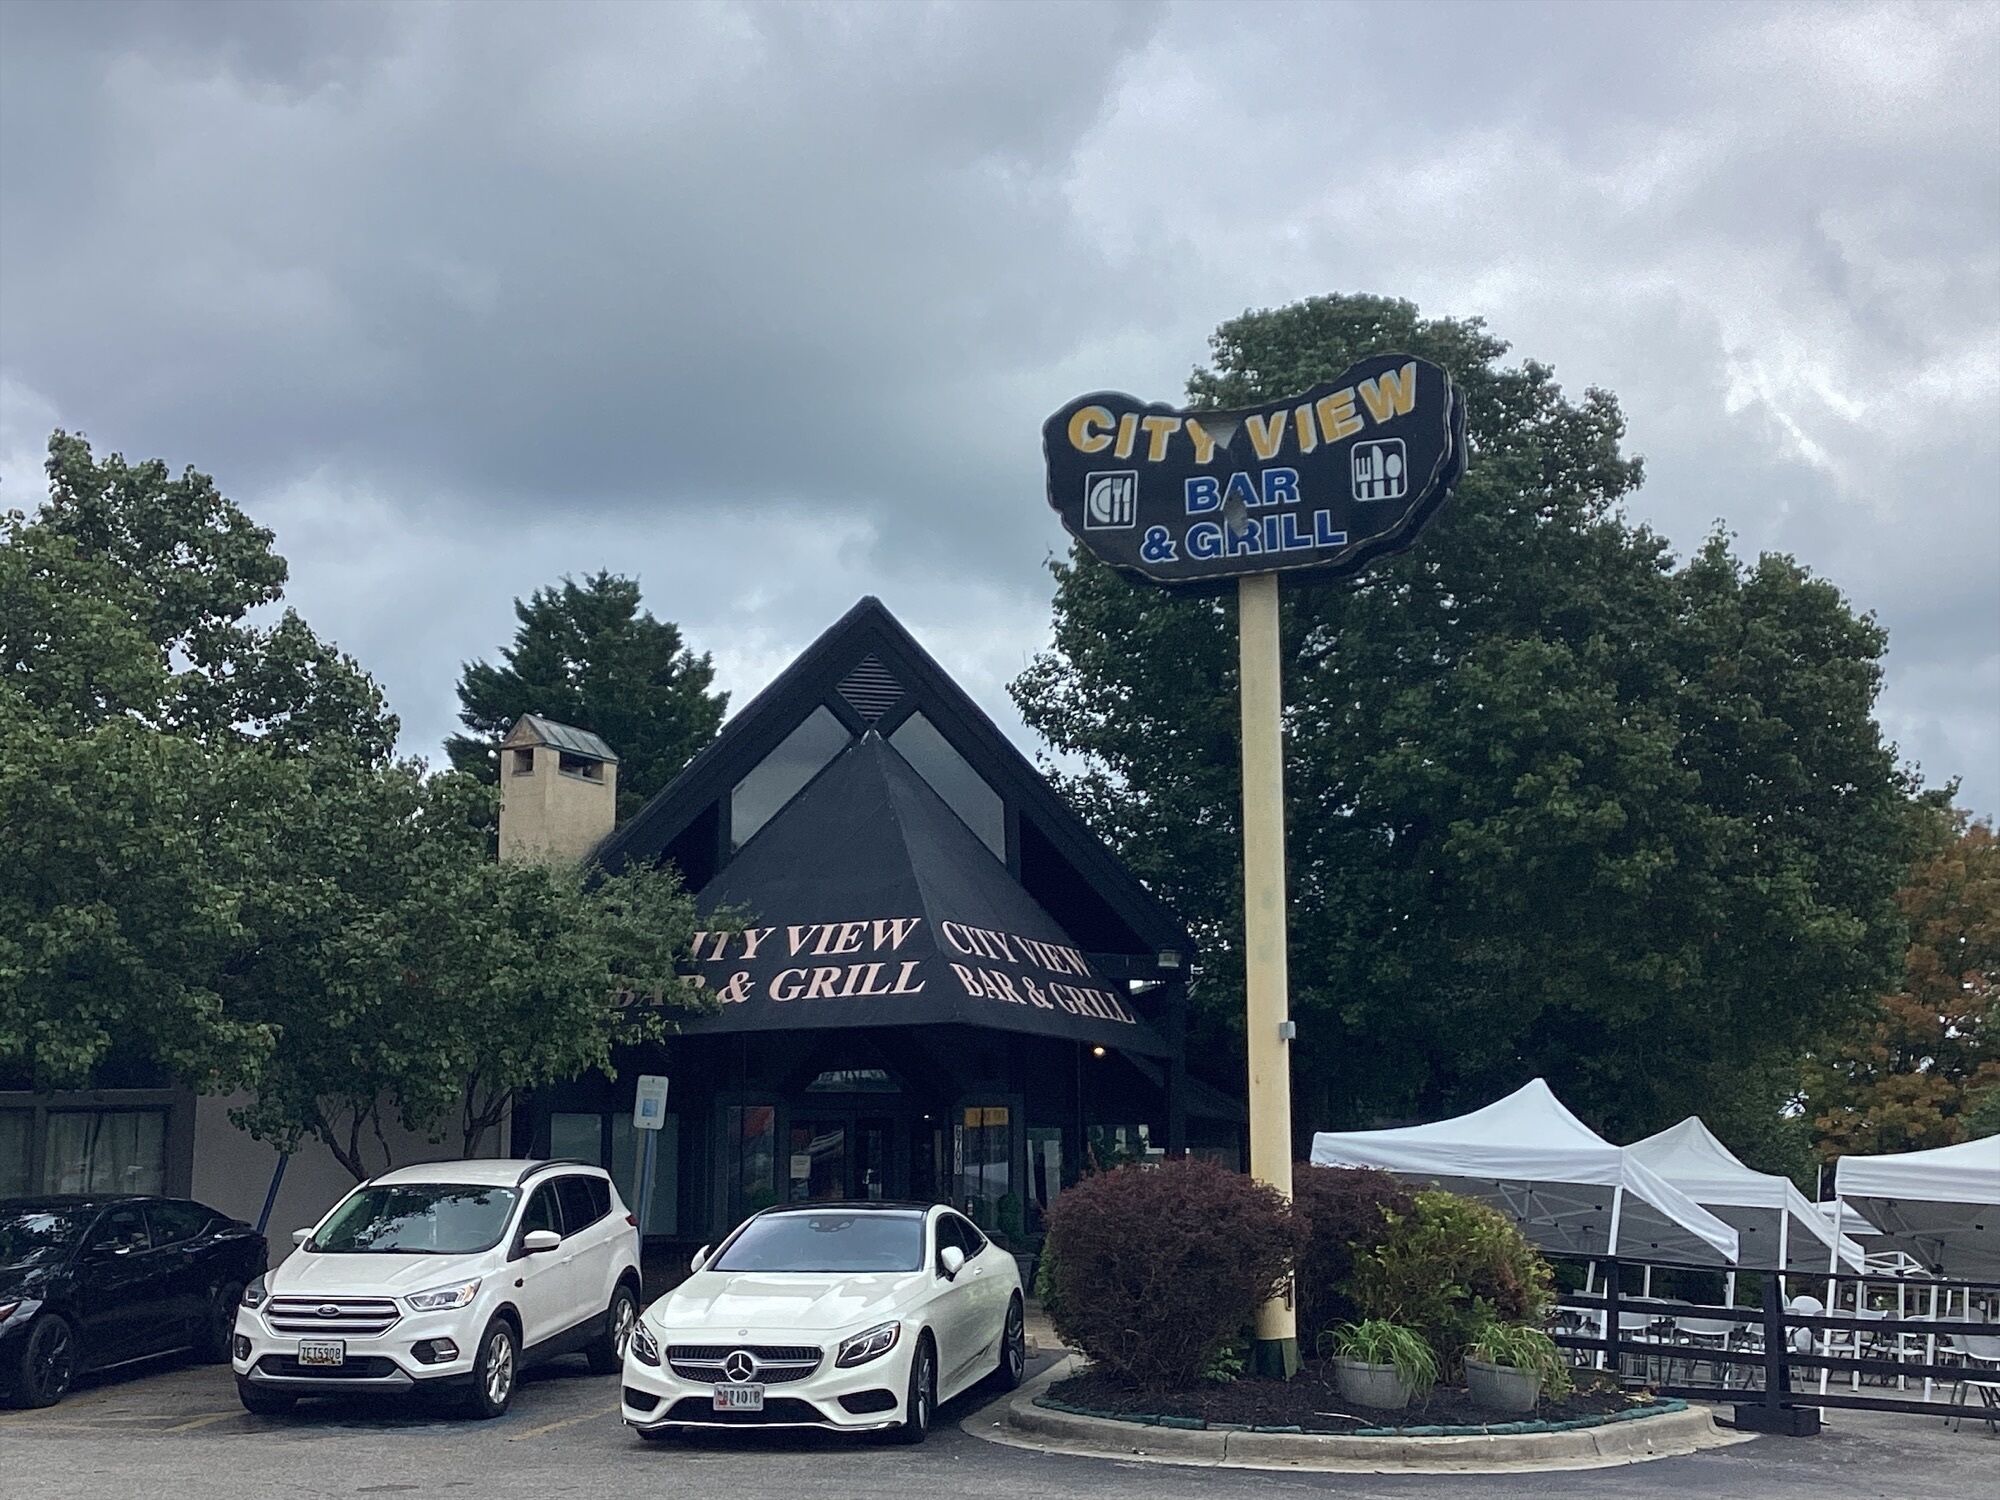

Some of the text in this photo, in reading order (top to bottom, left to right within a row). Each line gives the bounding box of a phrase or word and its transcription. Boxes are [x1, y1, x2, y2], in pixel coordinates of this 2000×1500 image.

[1068, 361, 1417, 464] CITY VIEW
[1185, 467, 1301, 515] BAR
[1140, 509, 1348, 564] & GRILL
[681, 917, 921, 962] ITY VIEW
[941, 920, 1091, 978] CITY VIEW
[716, 971, 756, 1004] &
[769, 961, 926, 1002] GRILL
[950, 963, 1136, 1024] BAR & GRILL
